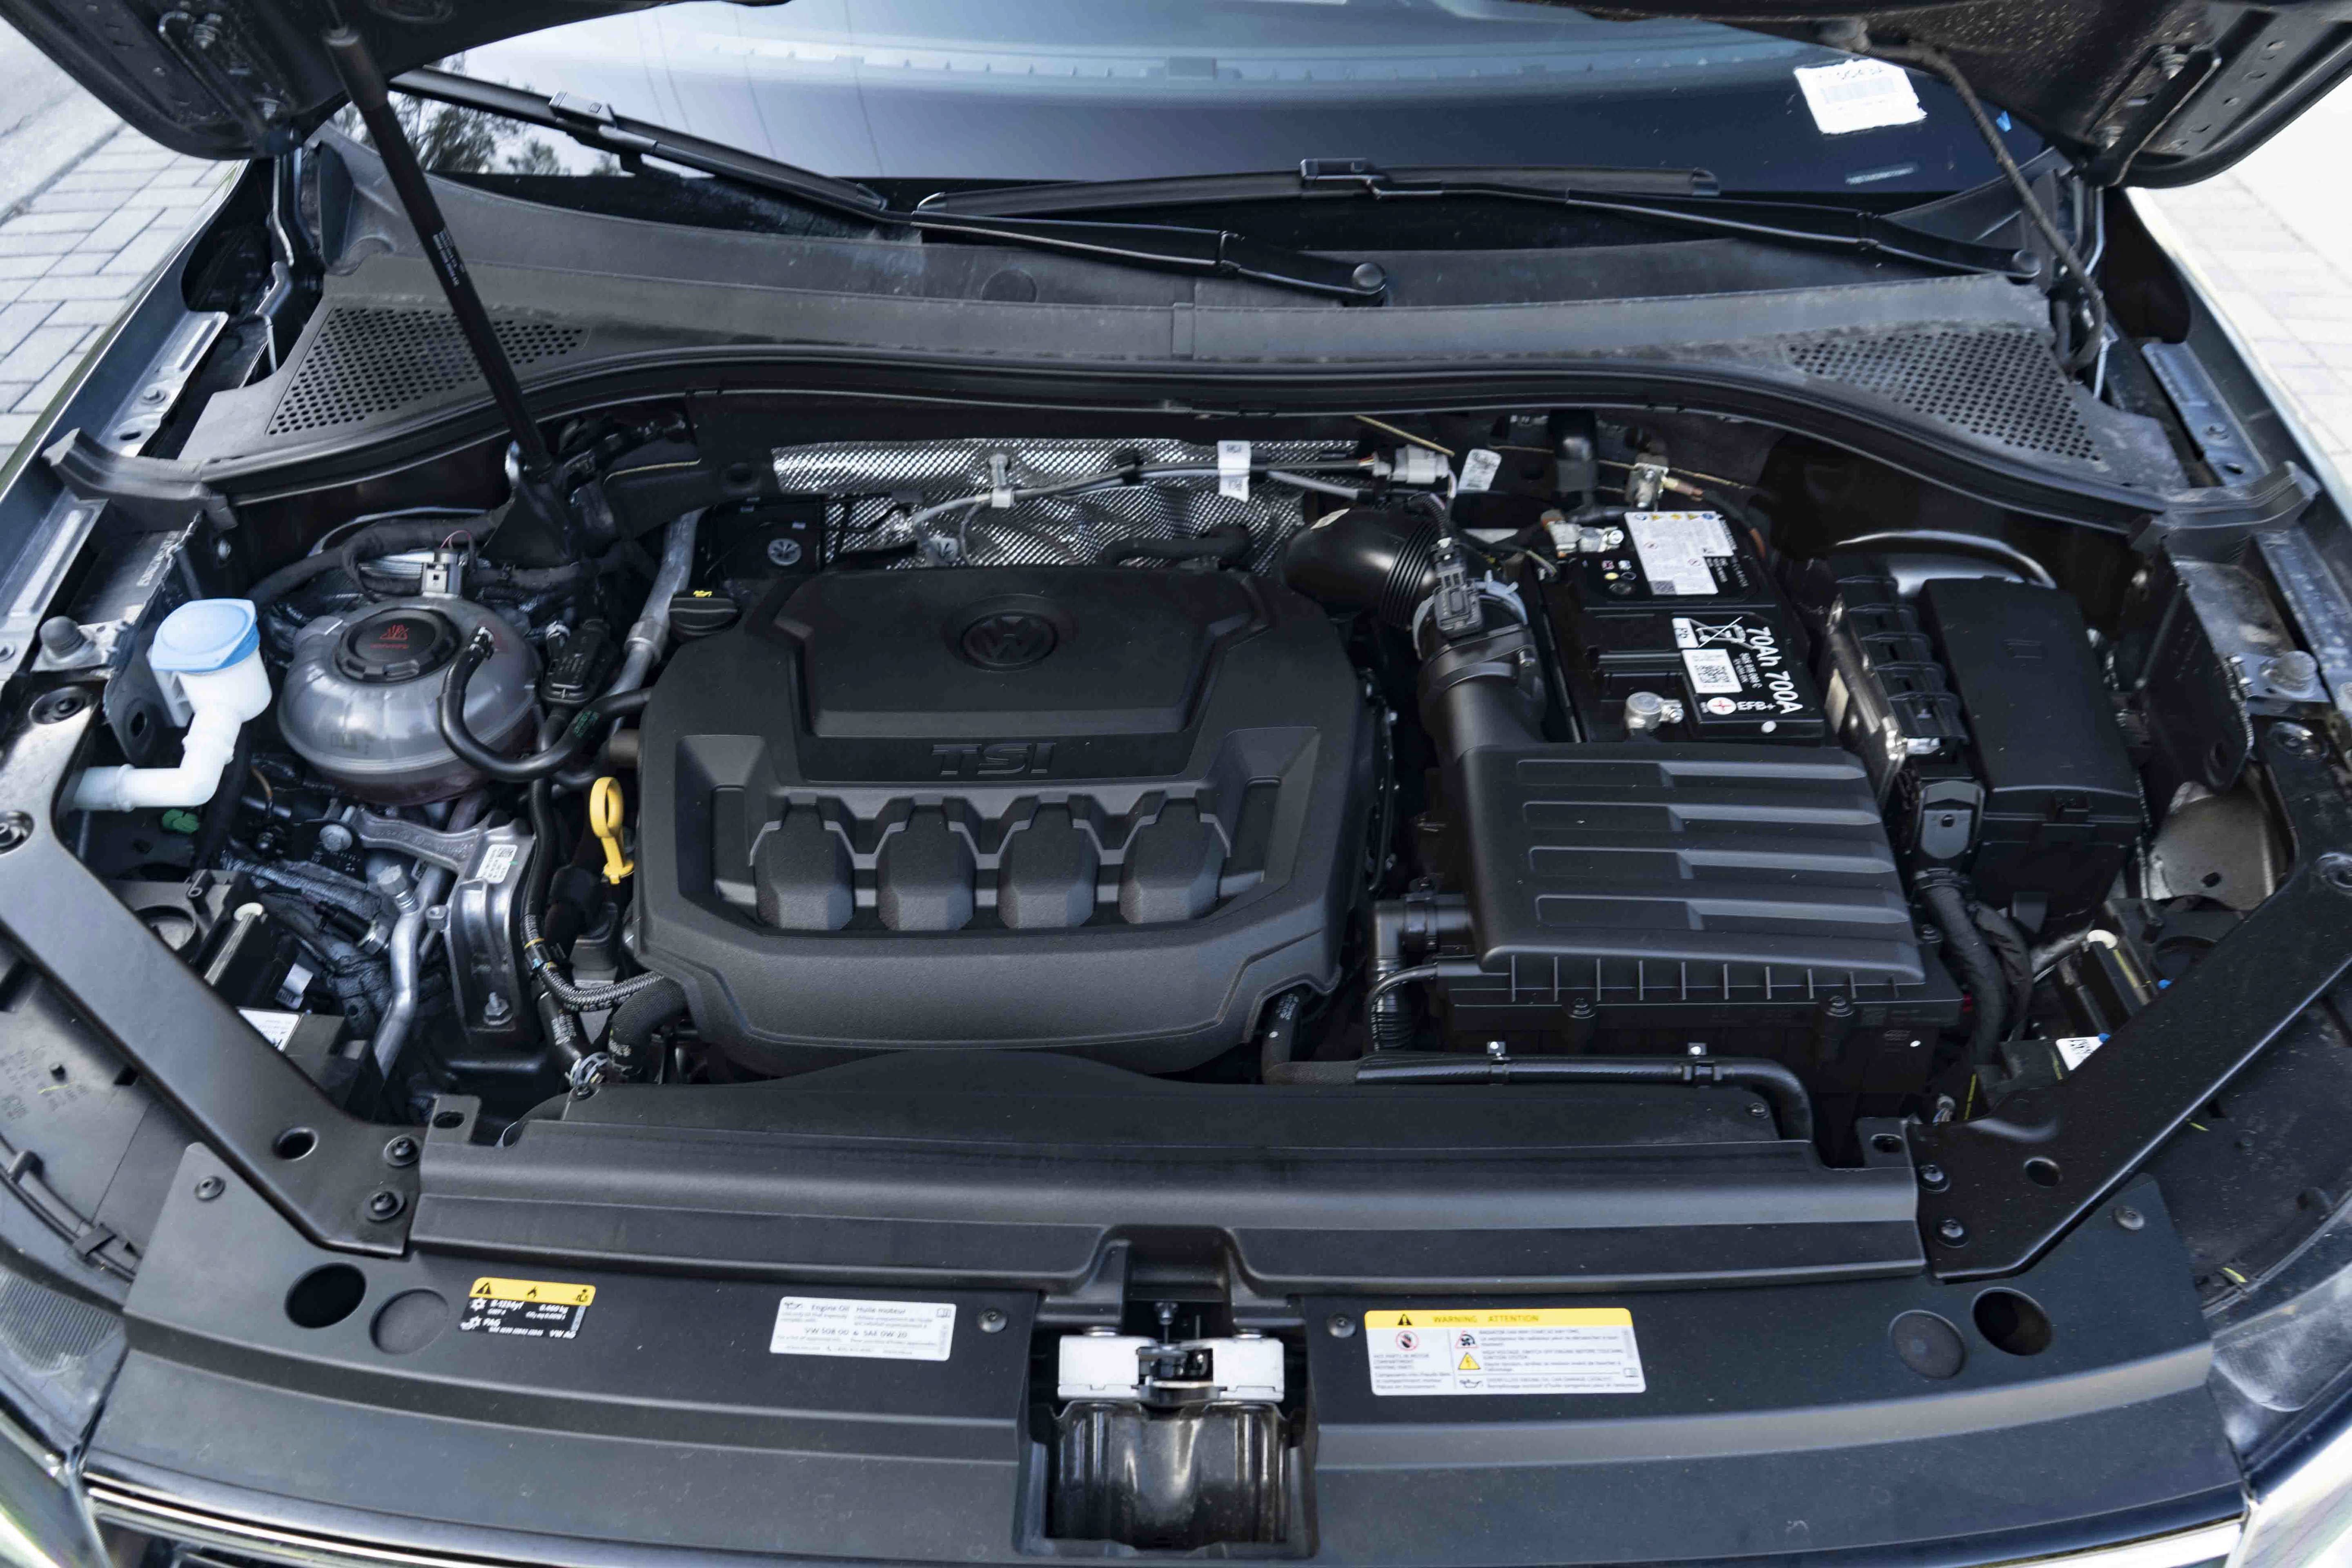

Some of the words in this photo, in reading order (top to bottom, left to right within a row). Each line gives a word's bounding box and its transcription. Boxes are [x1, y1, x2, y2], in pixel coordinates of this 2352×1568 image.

[1746, 626, 1782, 666] 70Ah
[1765, 670, 1804, 714] 700A
[931, 742, 1057, 776] TSI
